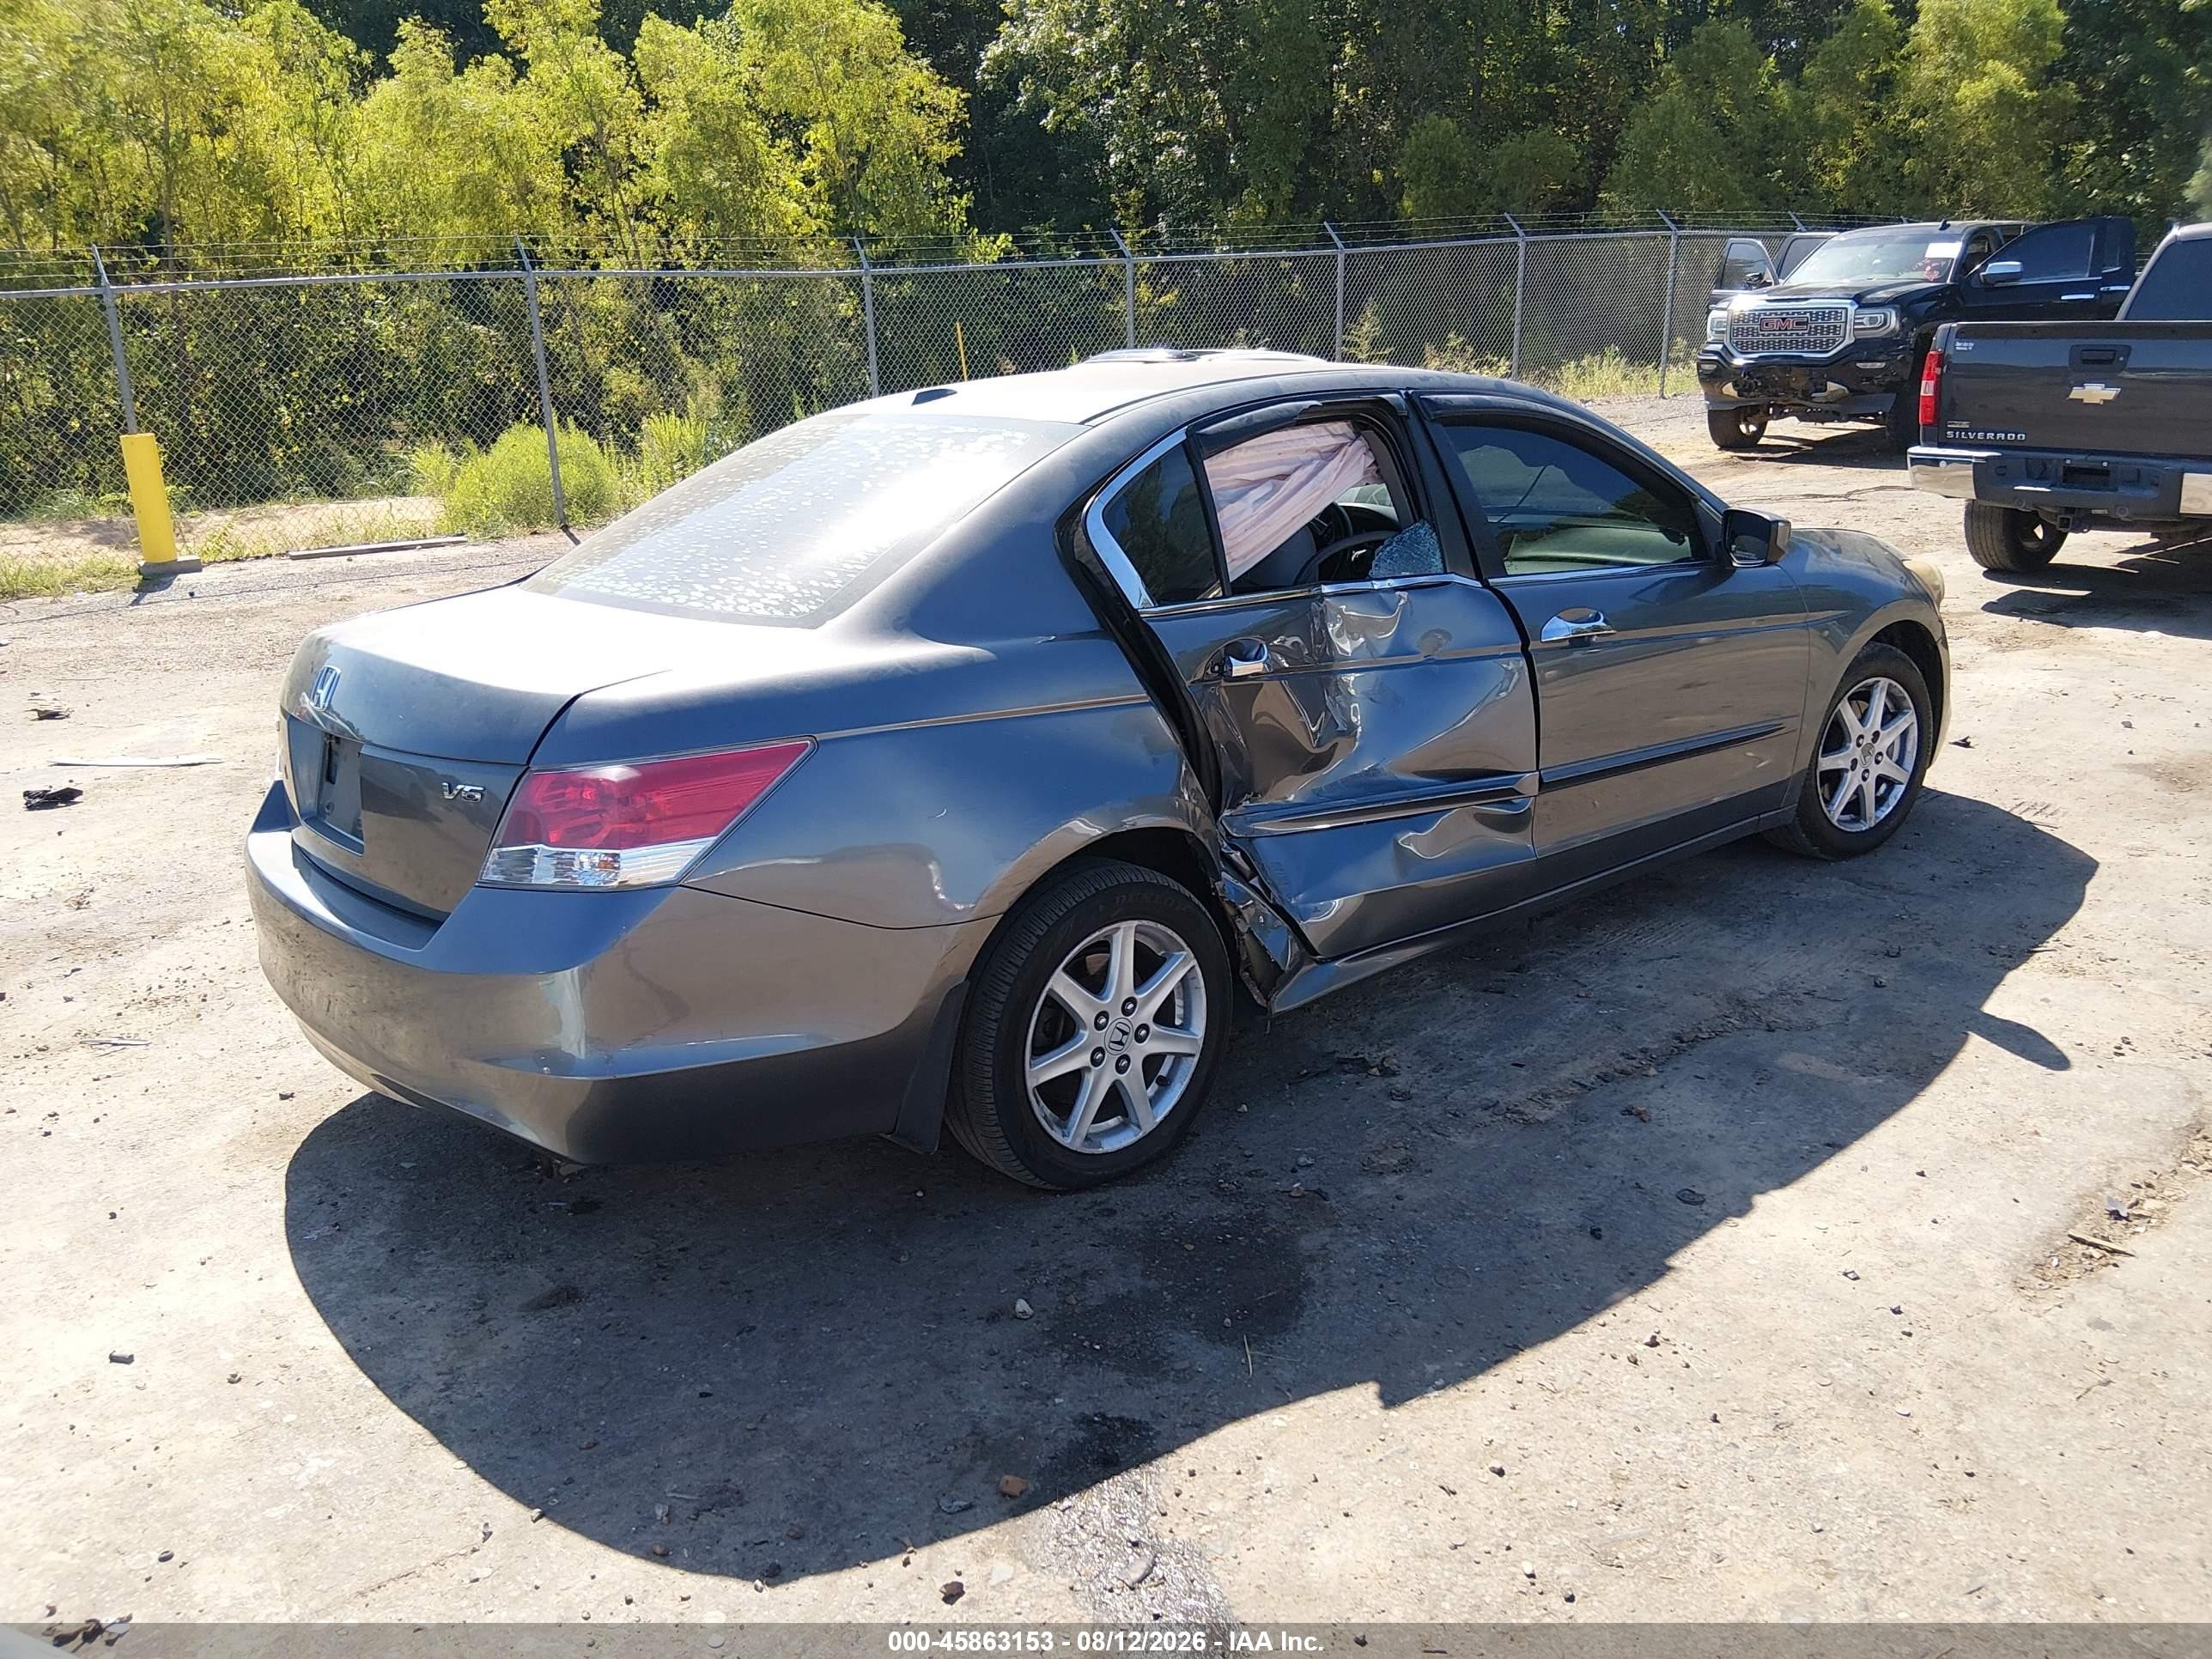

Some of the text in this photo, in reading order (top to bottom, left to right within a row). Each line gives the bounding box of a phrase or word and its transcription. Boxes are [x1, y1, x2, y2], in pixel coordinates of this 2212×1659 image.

[1760, 318, 1808, 331] GMC
[1946, 431, 2027, 441] SILVERADO
[441, 782, 484, 803] V6
